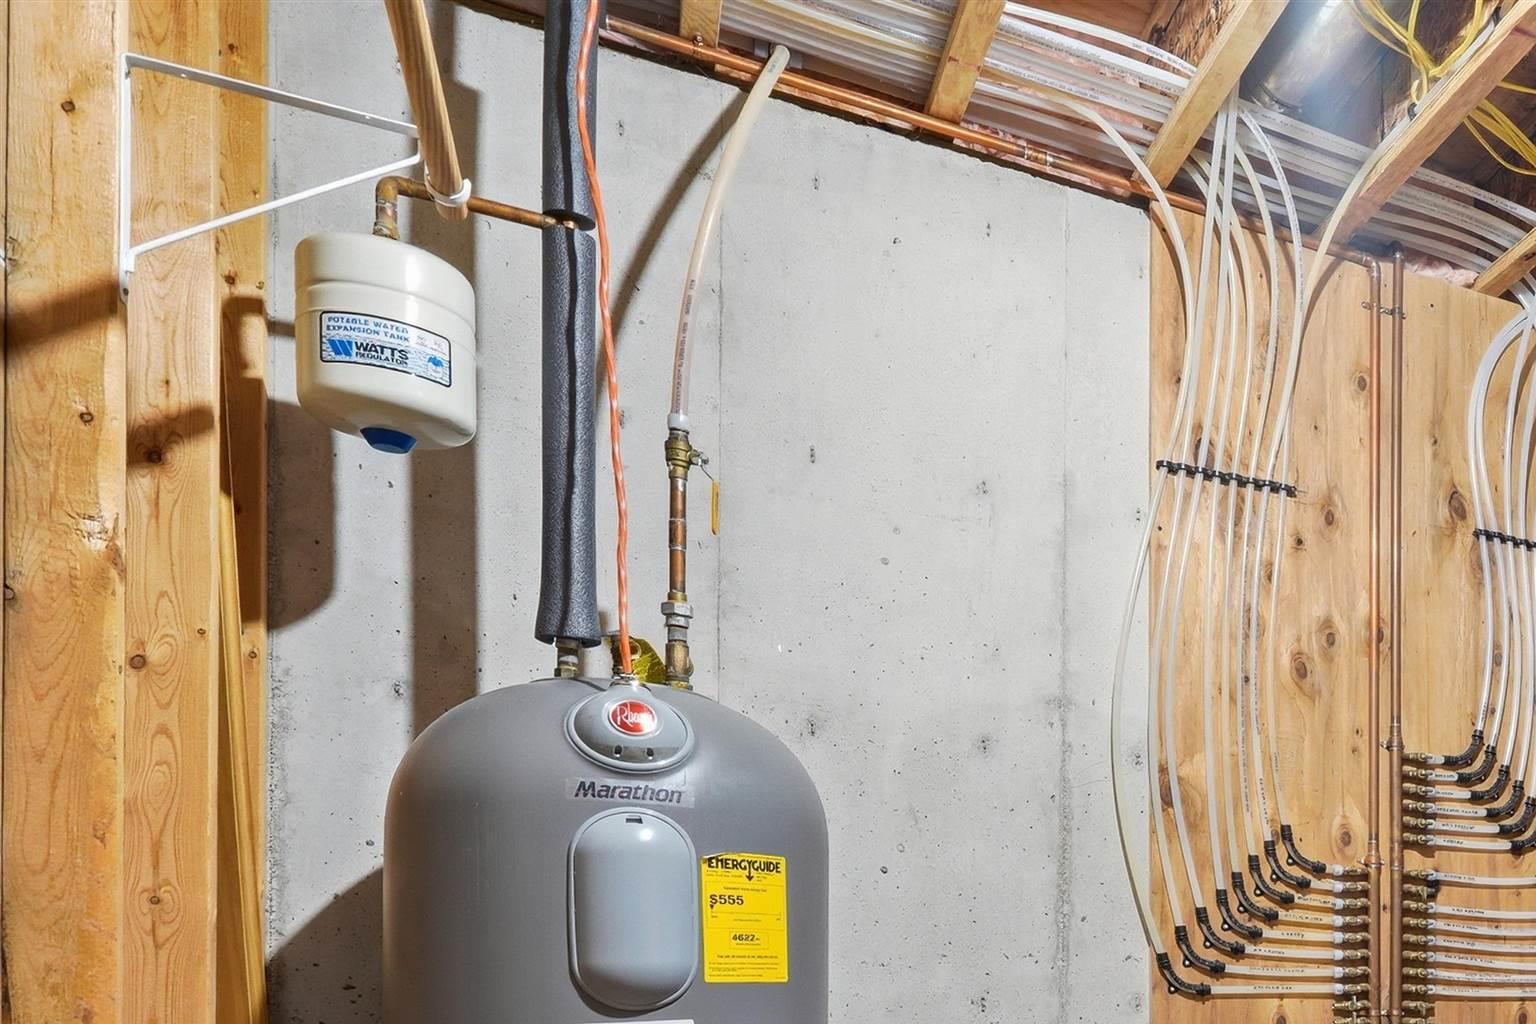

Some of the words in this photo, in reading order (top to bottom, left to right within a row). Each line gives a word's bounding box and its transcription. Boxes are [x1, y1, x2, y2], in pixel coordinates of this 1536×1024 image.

[355, 341, 409, 360] WATTS
[574, 780, 682, 803] Marathon
[709, 894, 744, 905] $555
